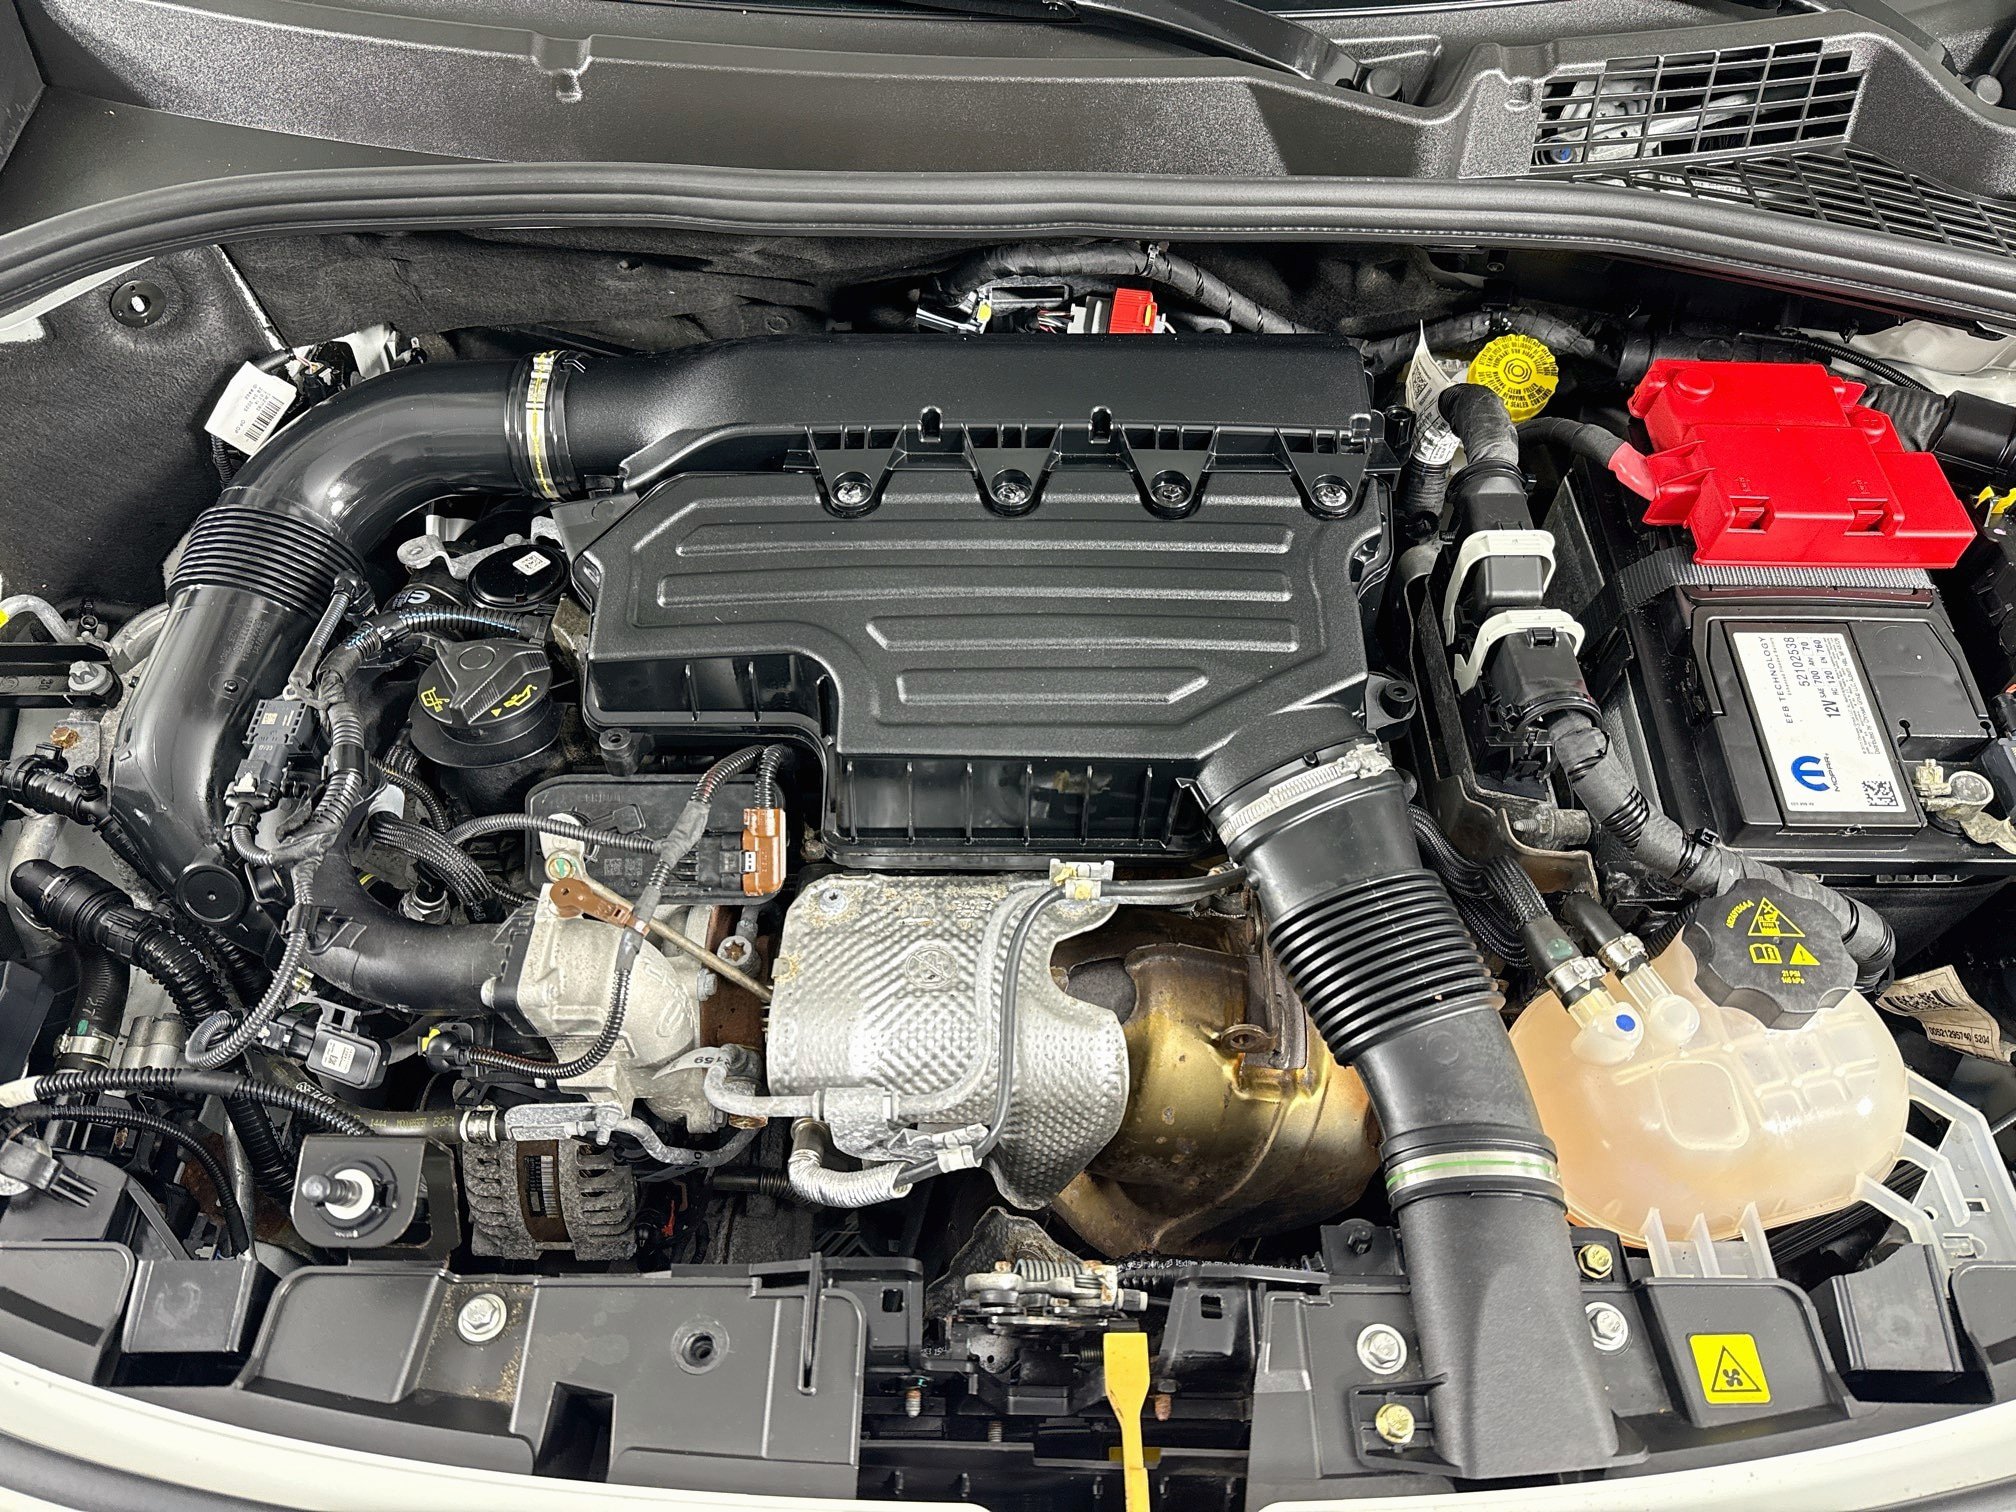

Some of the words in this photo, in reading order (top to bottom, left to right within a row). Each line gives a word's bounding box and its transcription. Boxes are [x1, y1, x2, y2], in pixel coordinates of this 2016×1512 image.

[1800, 641, 1810, 650] 70
[1812, 639, 1824, 652] 760
[1757, 636, 1786, 700] TECHNOLOGY
[1782, 637, 1811, 686] 52102538
[1809, 670, 1822, 684] 700
[1823, 670, 1835, 683] 120
[1817, 687, 1827, 698] SAE
[1781, 705, 1793, 723] EFB
[1821, 699, 1842, 717] 12V
[1822, 755, 1841, 792] MOPAR
[1974, 1033, 1990, 1044] 5204
